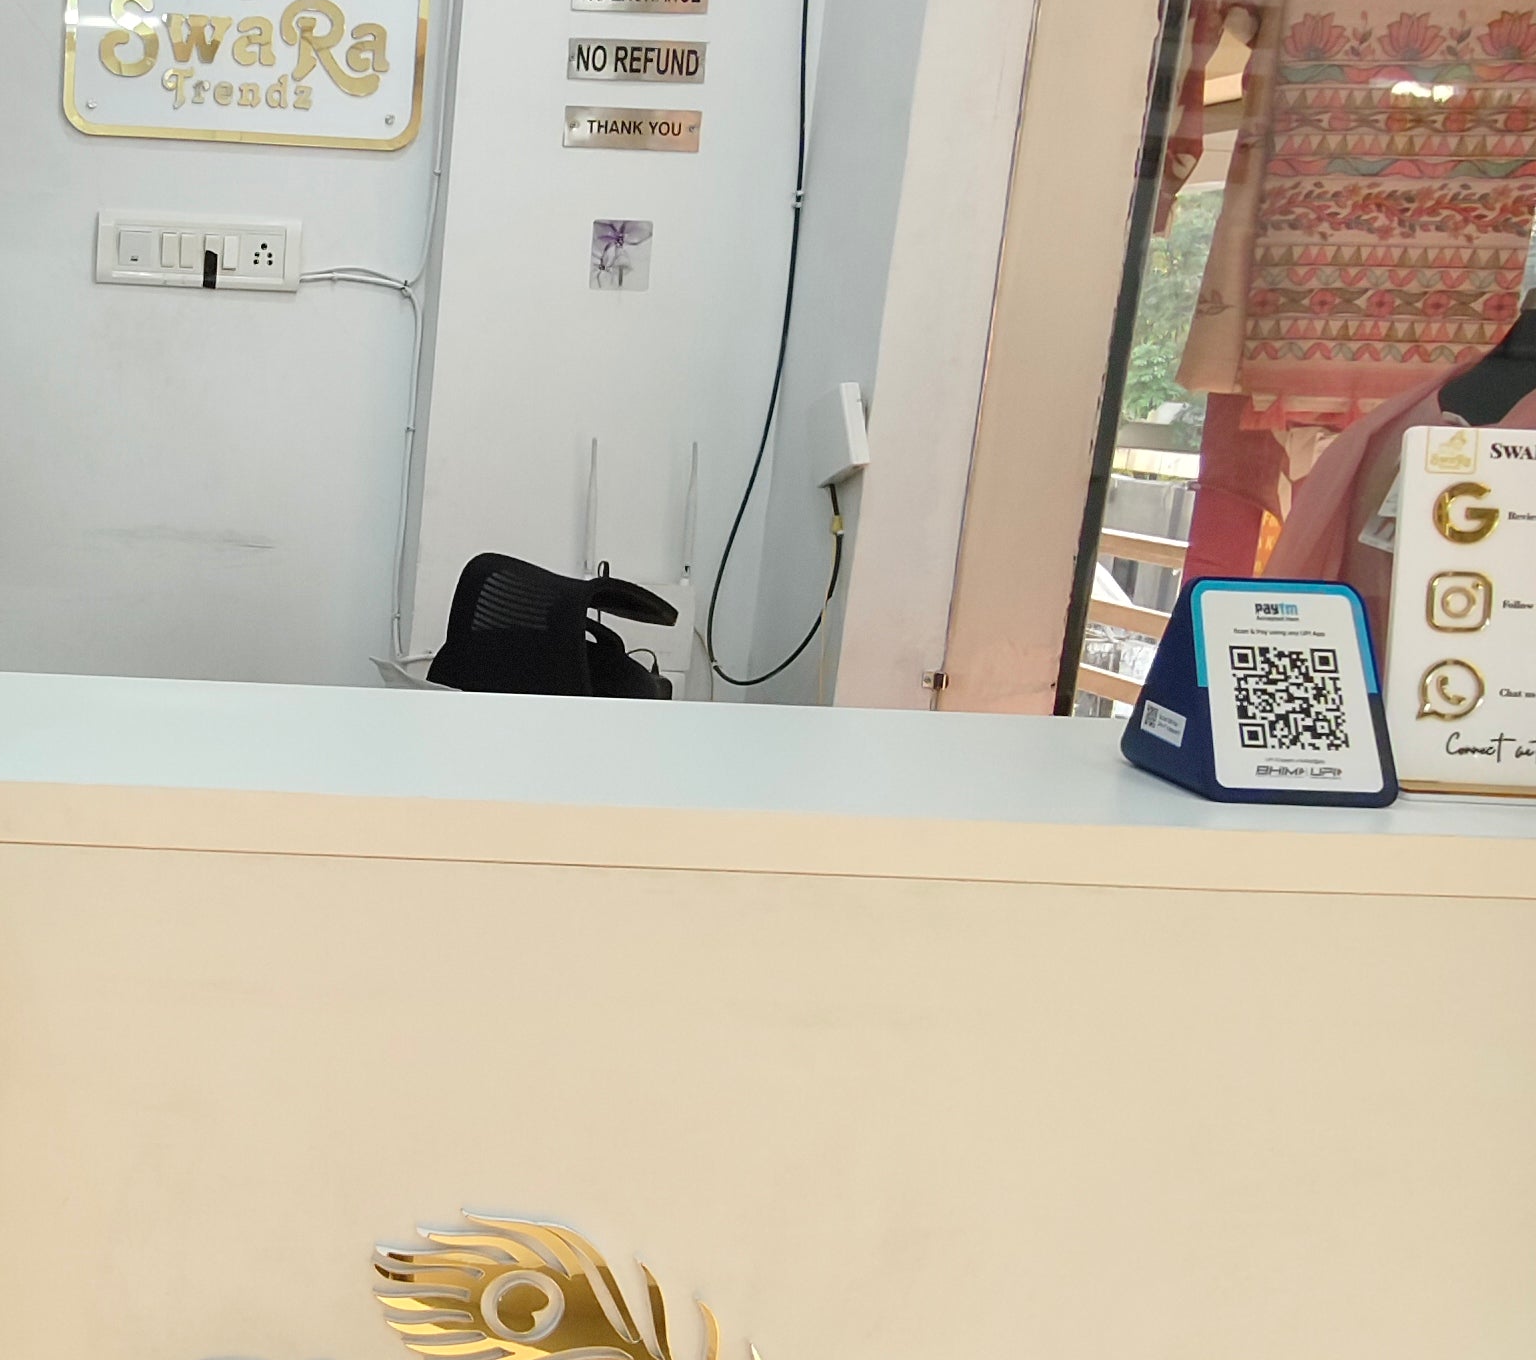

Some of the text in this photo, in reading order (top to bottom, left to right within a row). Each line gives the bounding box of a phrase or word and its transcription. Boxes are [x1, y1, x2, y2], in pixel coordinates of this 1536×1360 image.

[576, 44, 700, 77] NO REFUND
[161, 65, 314, 111] Trendz
[587, 119, 683, 138] THANK YOU
[1490, 442, 1536, 461] SWA
[1502, 599, 1534, 610] Follow
[1446, 731, 1517, 763] Connect
